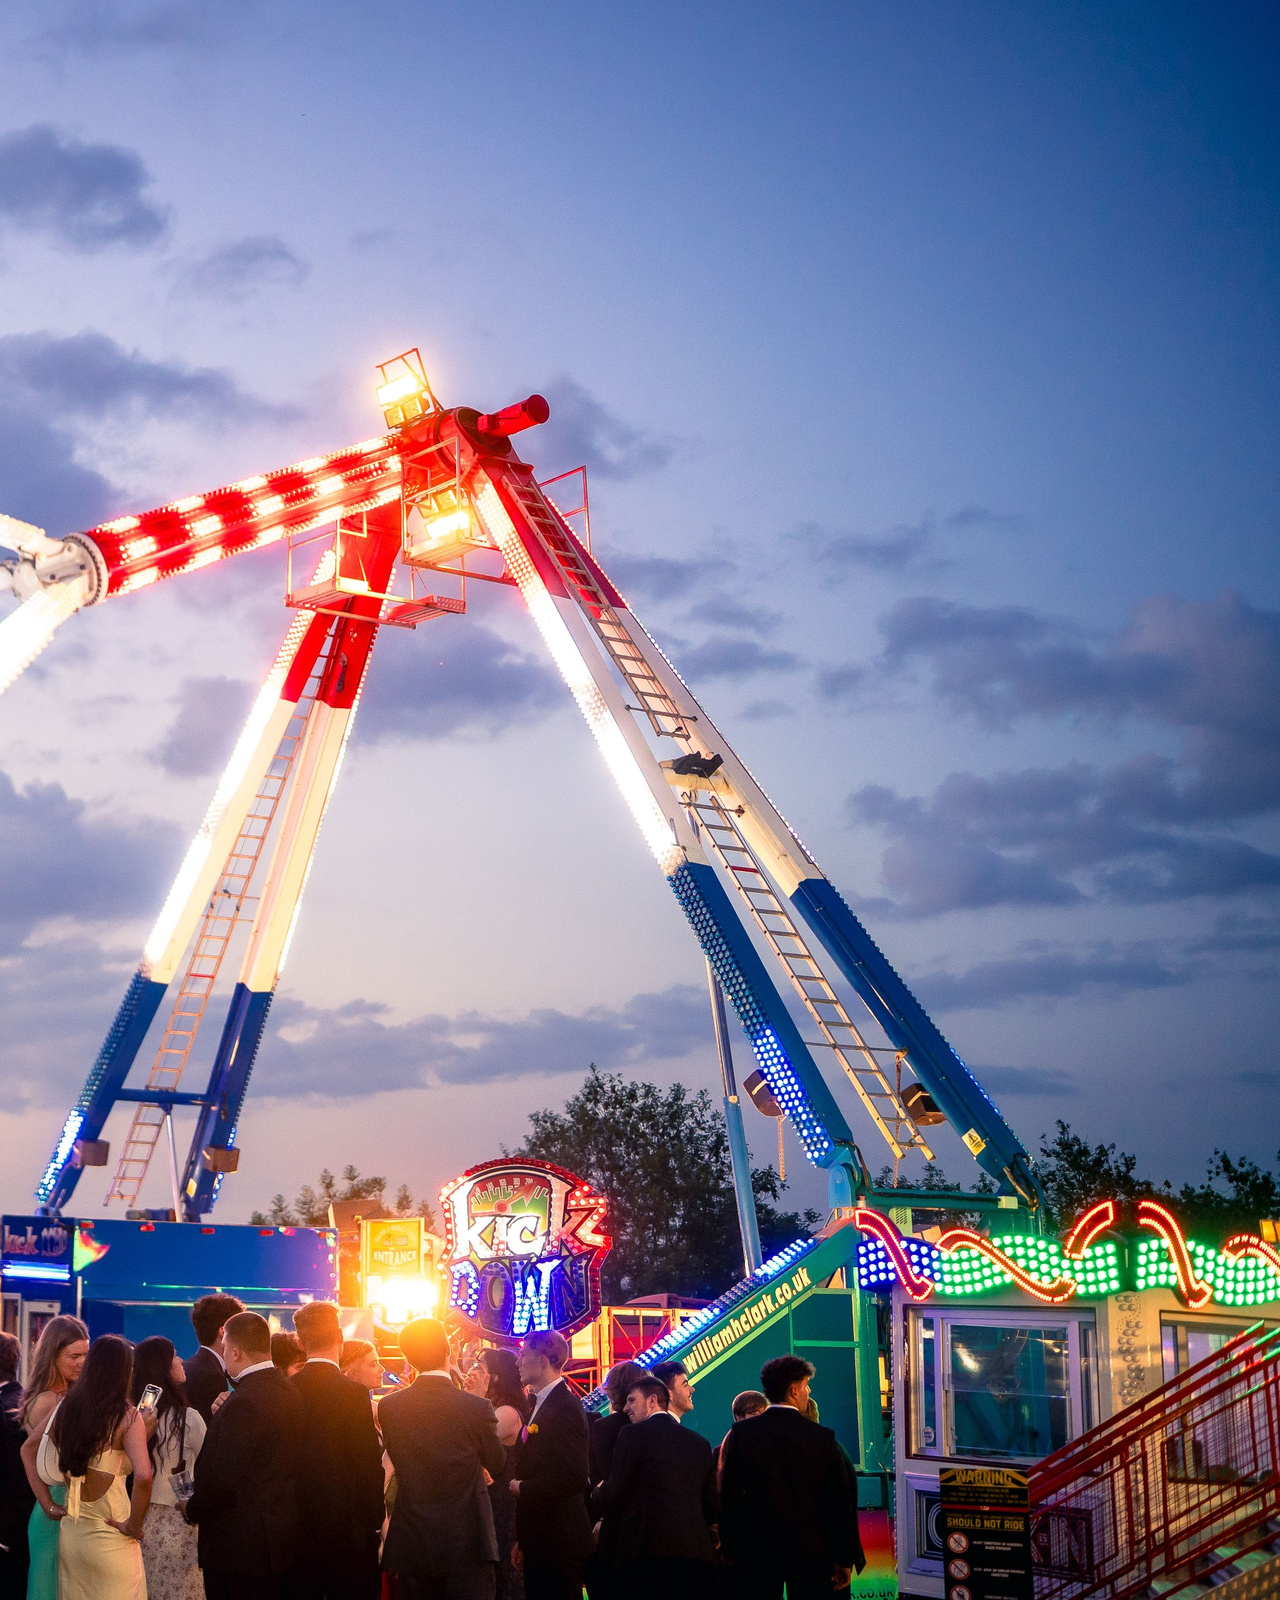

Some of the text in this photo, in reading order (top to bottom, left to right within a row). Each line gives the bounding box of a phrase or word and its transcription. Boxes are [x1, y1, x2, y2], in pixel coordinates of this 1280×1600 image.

[373, 1250, 417, 1266] ENTRANCE
[449, 1255, 590, 1335] DOWN
[682, 1266, 812, 1375] williamhclark.co.uk
[955, 1470, 1012, 1485] WARNING
[947, 1517, 1025, 1530] SHOULD NOT RIDE
